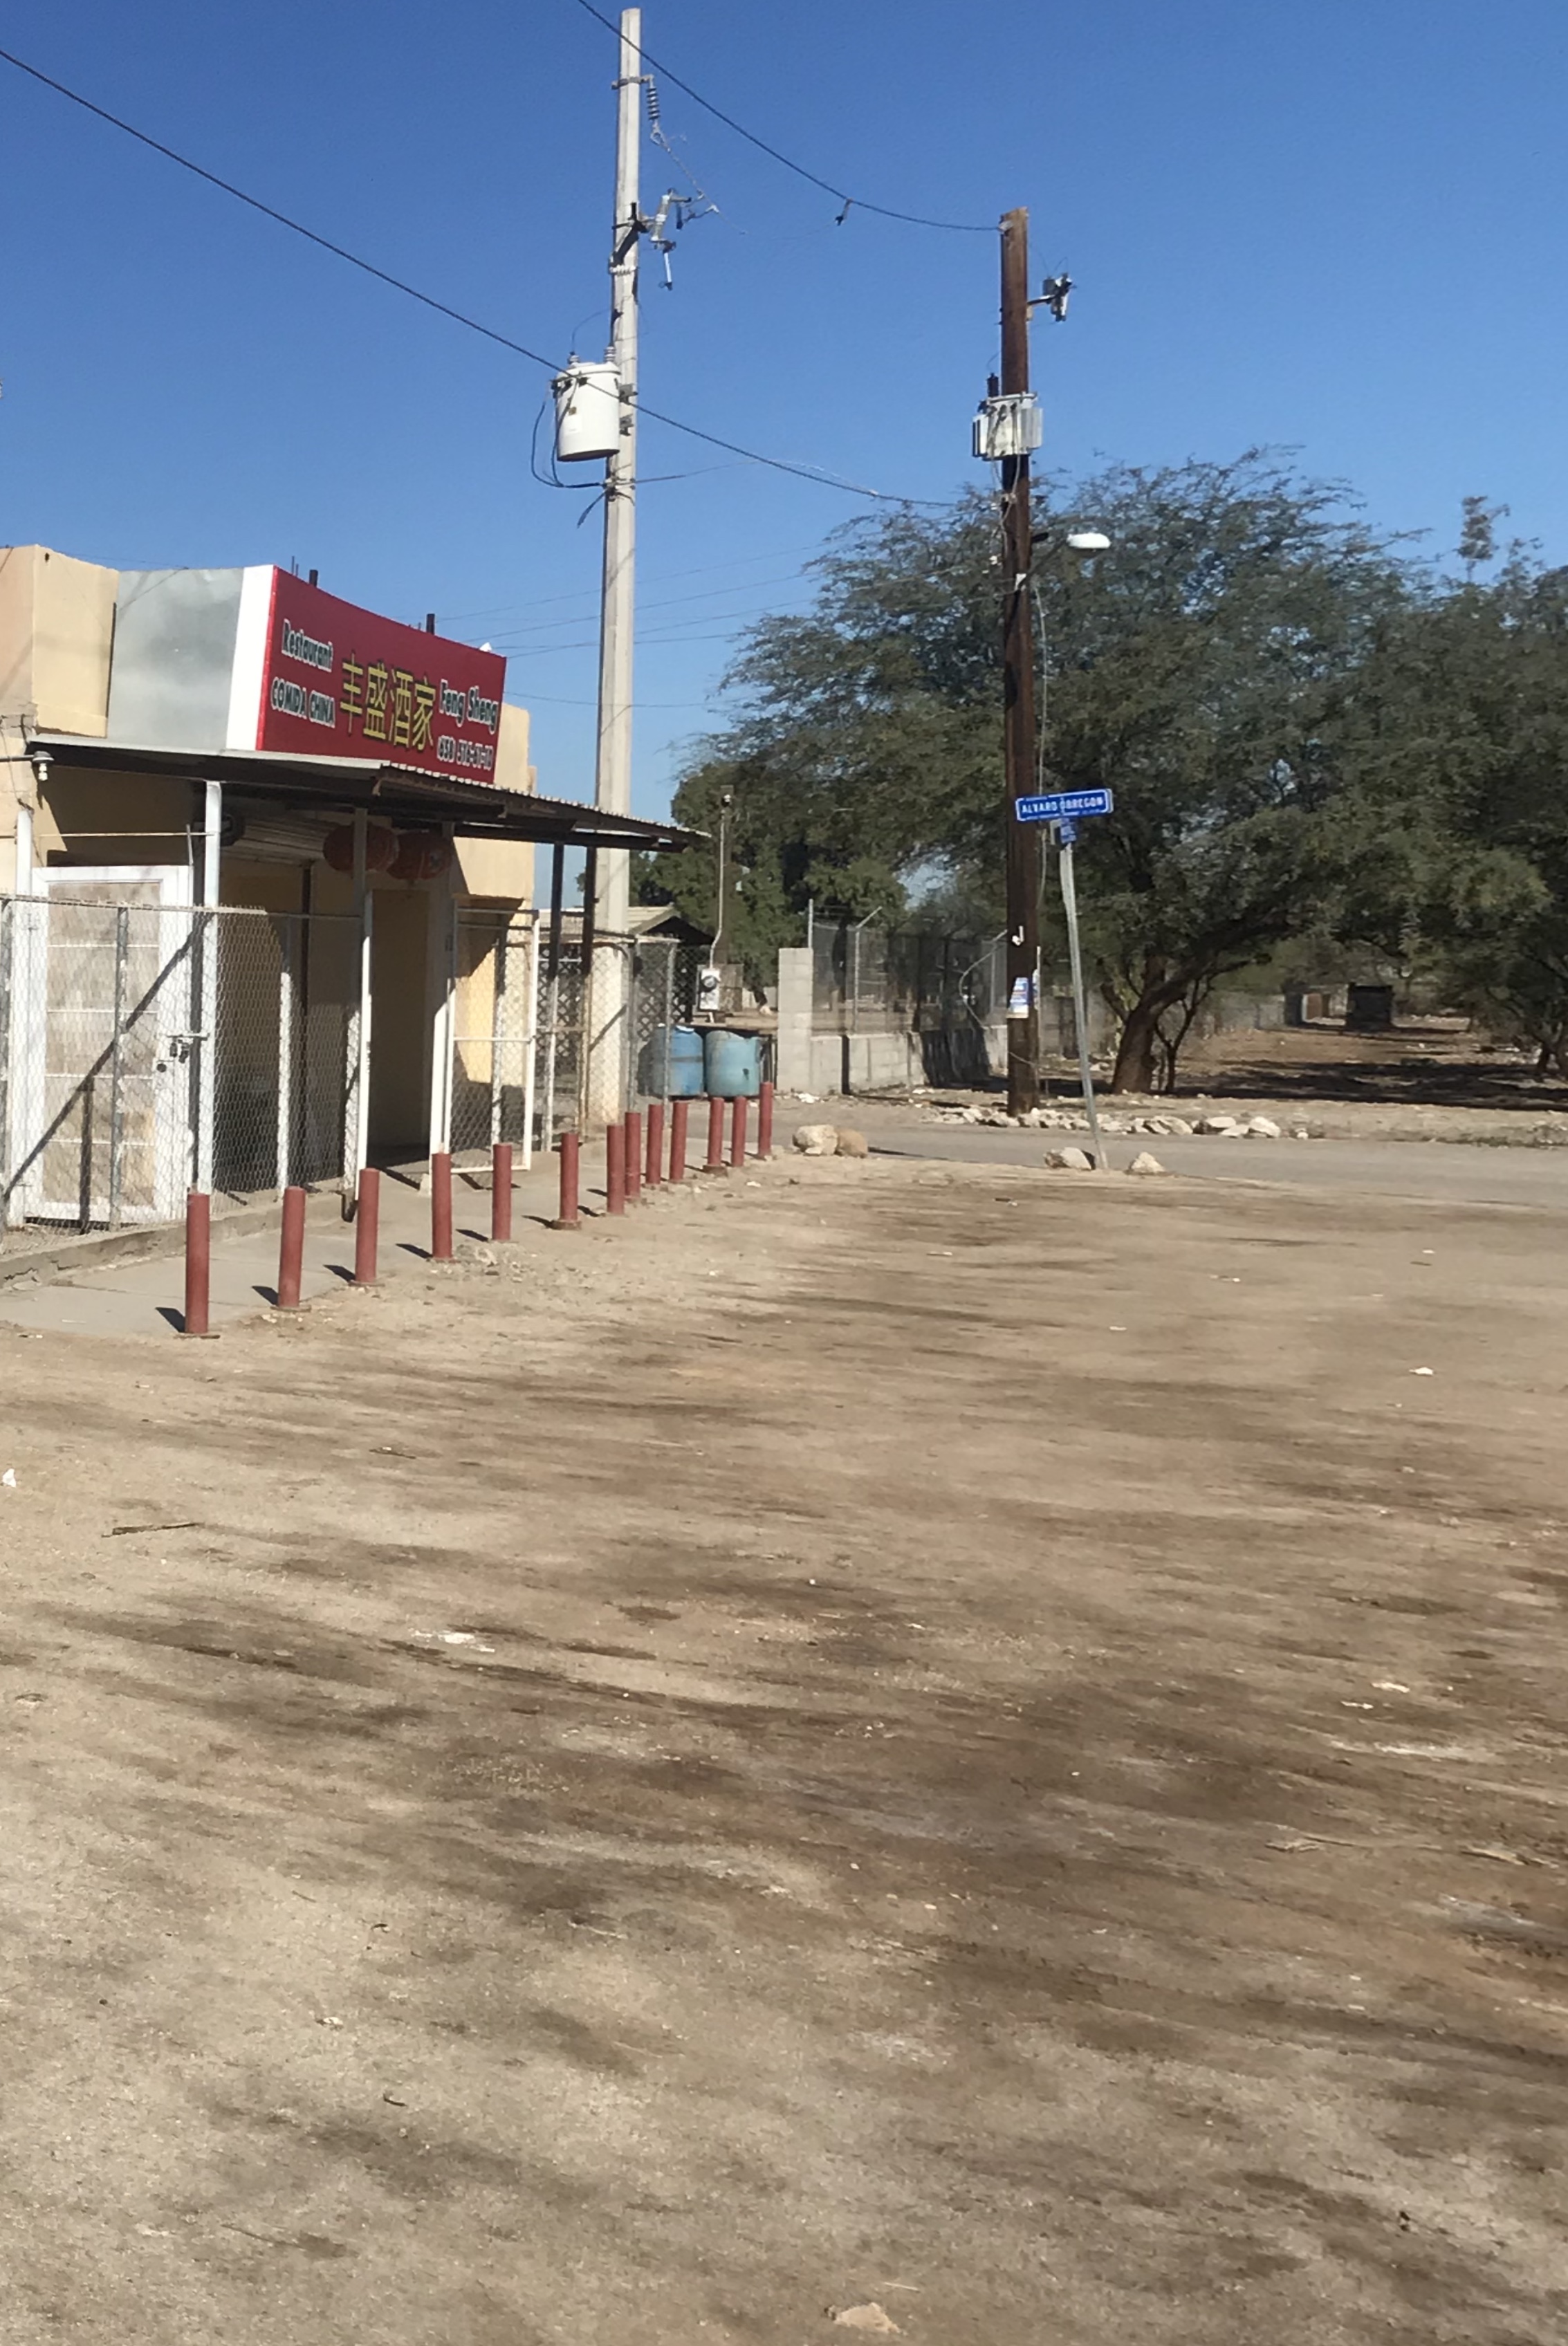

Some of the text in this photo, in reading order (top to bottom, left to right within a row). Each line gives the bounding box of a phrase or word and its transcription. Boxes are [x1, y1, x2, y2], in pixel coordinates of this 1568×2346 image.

[282, 618, 333, 672] Restaurant
[270, 677, 335, 728] COMIDA CHINA
[340, 652, 436, 750] 丰盛酒家
[440, 679, 498, 735] Feng Sheng
[1022, 801, 1058, 813] ALVARO
[1060, 797, 1103, 809] OBREGON
